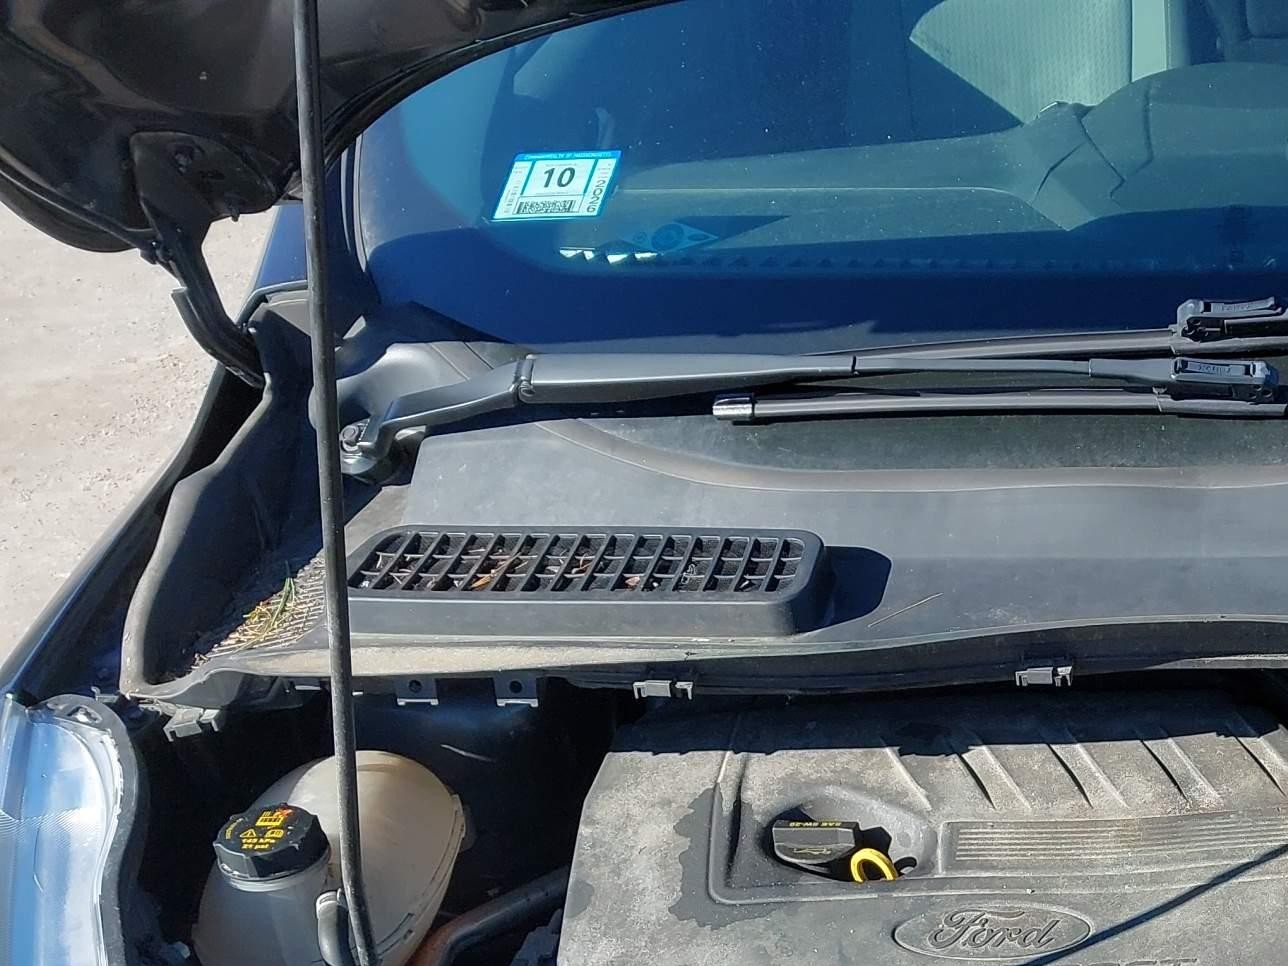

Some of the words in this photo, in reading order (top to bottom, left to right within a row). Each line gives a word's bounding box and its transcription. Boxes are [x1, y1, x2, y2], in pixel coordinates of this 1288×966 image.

[544, 167, 575, 188] 10
[586, 179, 606, 213] 2026
[926, 906, 1060, 950] Ford
